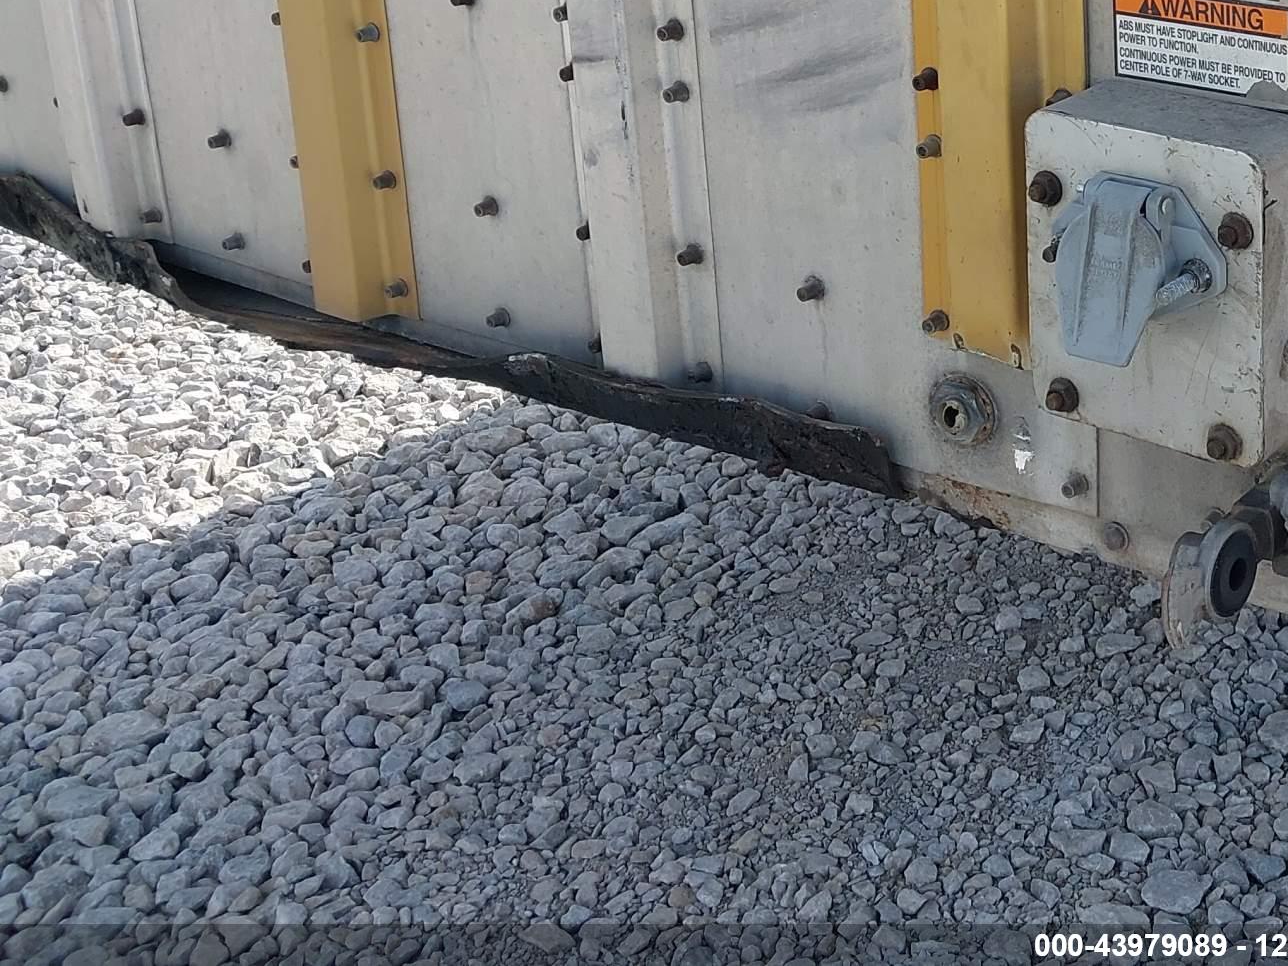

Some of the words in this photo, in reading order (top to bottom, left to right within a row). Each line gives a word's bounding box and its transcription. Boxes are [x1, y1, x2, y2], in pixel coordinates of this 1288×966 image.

[1119, 19, 1134, 32] ABS
[1135, 21, 1155, 35] MUST
[1156, 24, 1176, 38] HAVE
[1177, 28, 1219, 45] STOPLIGHT
[1219, 35, 1236, 47] AND
[1237, 37, 1288, 55] CONTINUOUS
[1119, 31, 1146, 46] POWER
[1147, 35, 1158, 48] TO
[1160, 38, 1199, 54] FUNCTION.
[1119, 46, 1168, 64] CONTINUOUS
[1169, 54, 1197, 69] POWER
[1198, 58, 1220, 73] MUST
[1221, 63, 1233, 75] BE
[1233, 65, 1274, 81] PROVIDED
[1274, 71, 1286, 83] TO
[1119, 59, 1149, 73] CENTER
[1150, 64, 1171, 77] POLE
[1172, 67, 1183, 79] OF
[1183, 70, 1207, 83] 7-WAY
[1208, 73, 1241, 89] SOCKET.
